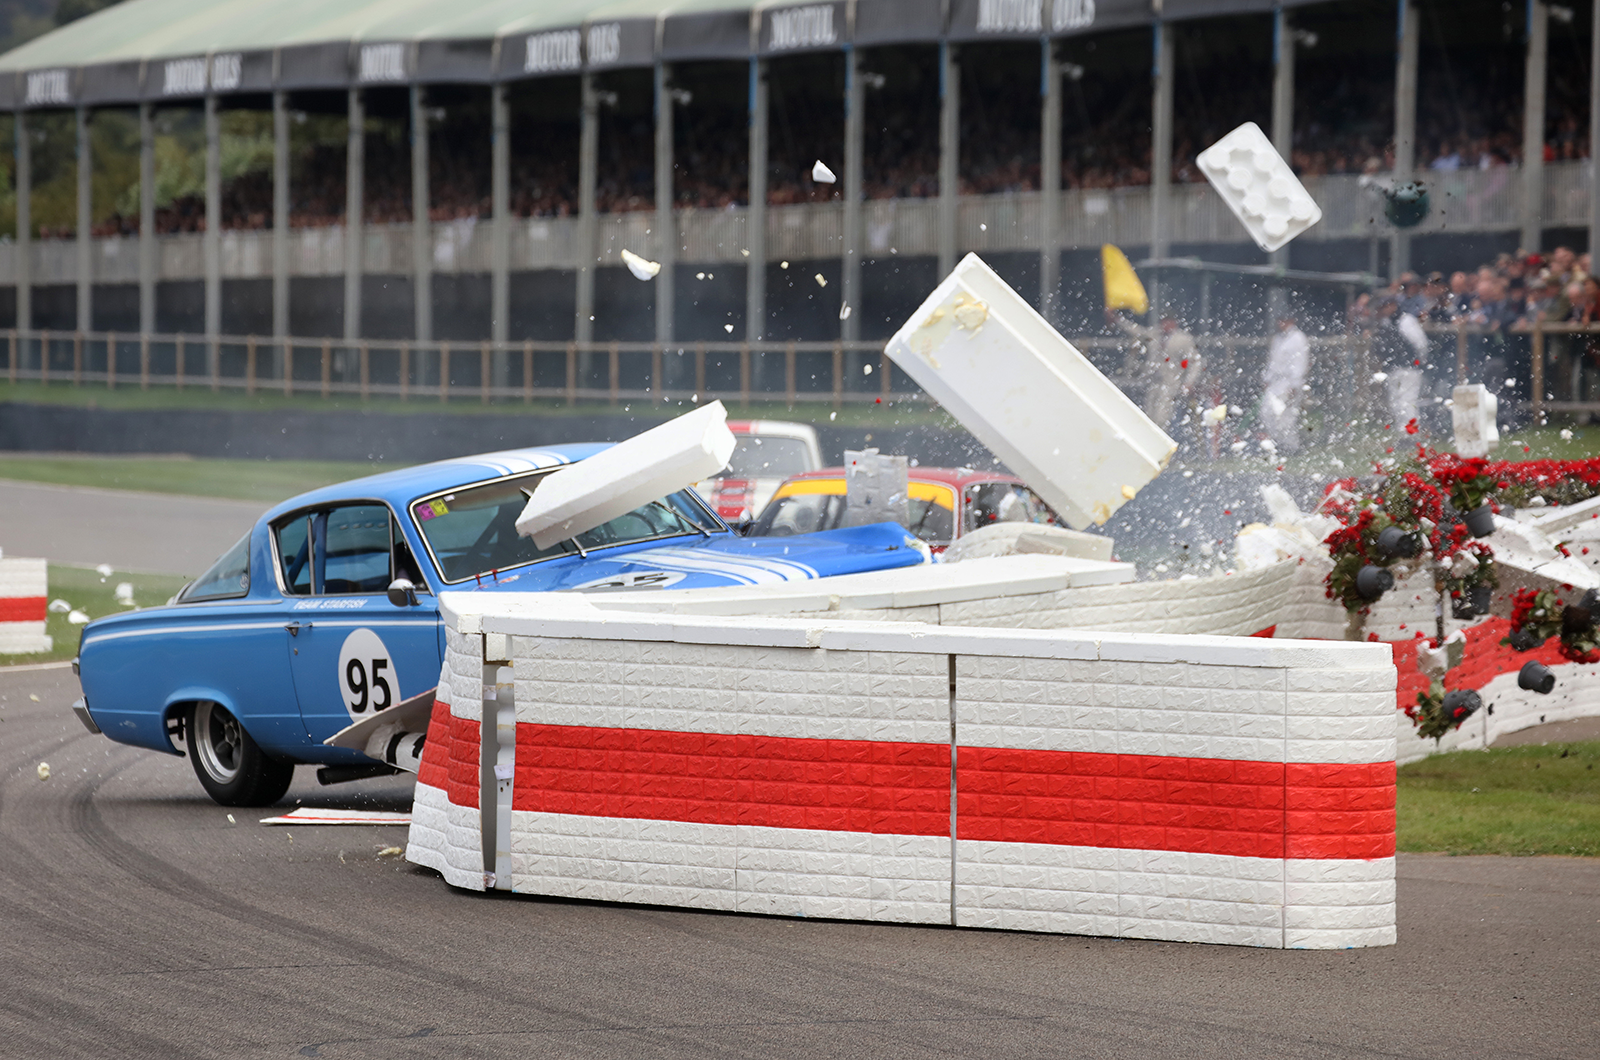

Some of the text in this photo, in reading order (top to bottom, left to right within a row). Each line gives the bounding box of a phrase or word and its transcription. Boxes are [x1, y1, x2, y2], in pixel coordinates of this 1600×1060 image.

[524, 22, 621, 73] MOTOR OILS
[768, 5, 838, 51] MOTUL
[293, 600, 323, 610] TEAM
[346, 658, 391, 714] 95
